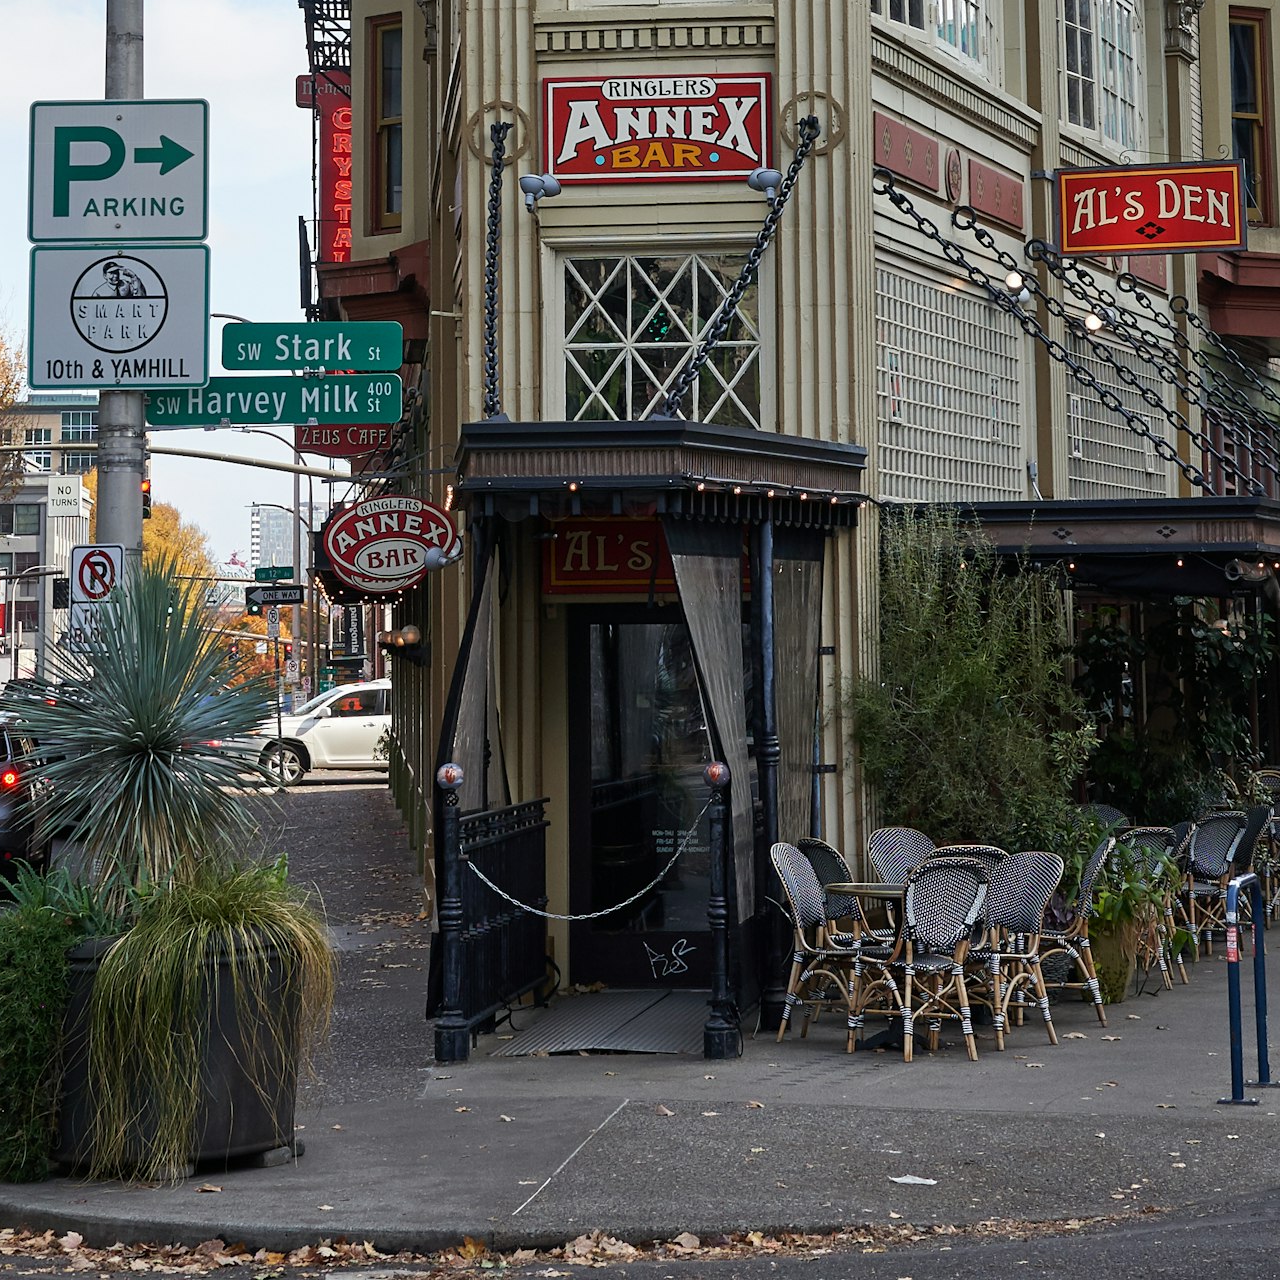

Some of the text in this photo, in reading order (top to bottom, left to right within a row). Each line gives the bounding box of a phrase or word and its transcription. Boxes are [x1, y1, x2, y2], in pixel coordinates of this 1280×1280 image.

[608, 78, 712, 99] RINGLERS
[556, 96, 759, 164] ANNEX
[611, 142, 704, 169] BAR
[332, 107, 352, 263] CRYSTA
[1071, 178, 1232, 234] AL'S DEN
[78, 303, 159, 319] SMART
[88, 324, 148, 339] PARK
[237, 333, 381, 361] SW Stark St
[46, 358, 190, 379] 10th & YAMHILL
[368, 382, 392, 396] 400
[156, 384, 359, 420] SW Harvey Milk
[368, 399, 381, 413] St
[301, 426, 388, 445] ZEUS CAFE
[57, 486, 72, 495] NO
[360, 499, 420, 516] RINGLERS
[335, 512, 447, 555] ANNEX
[366, 548, 419, 569] BAR
[562, 530, 653, 571] AL'S
[263, 591, 298, 599] ONE WAY
[349, 606, 360, 654] patagonia
